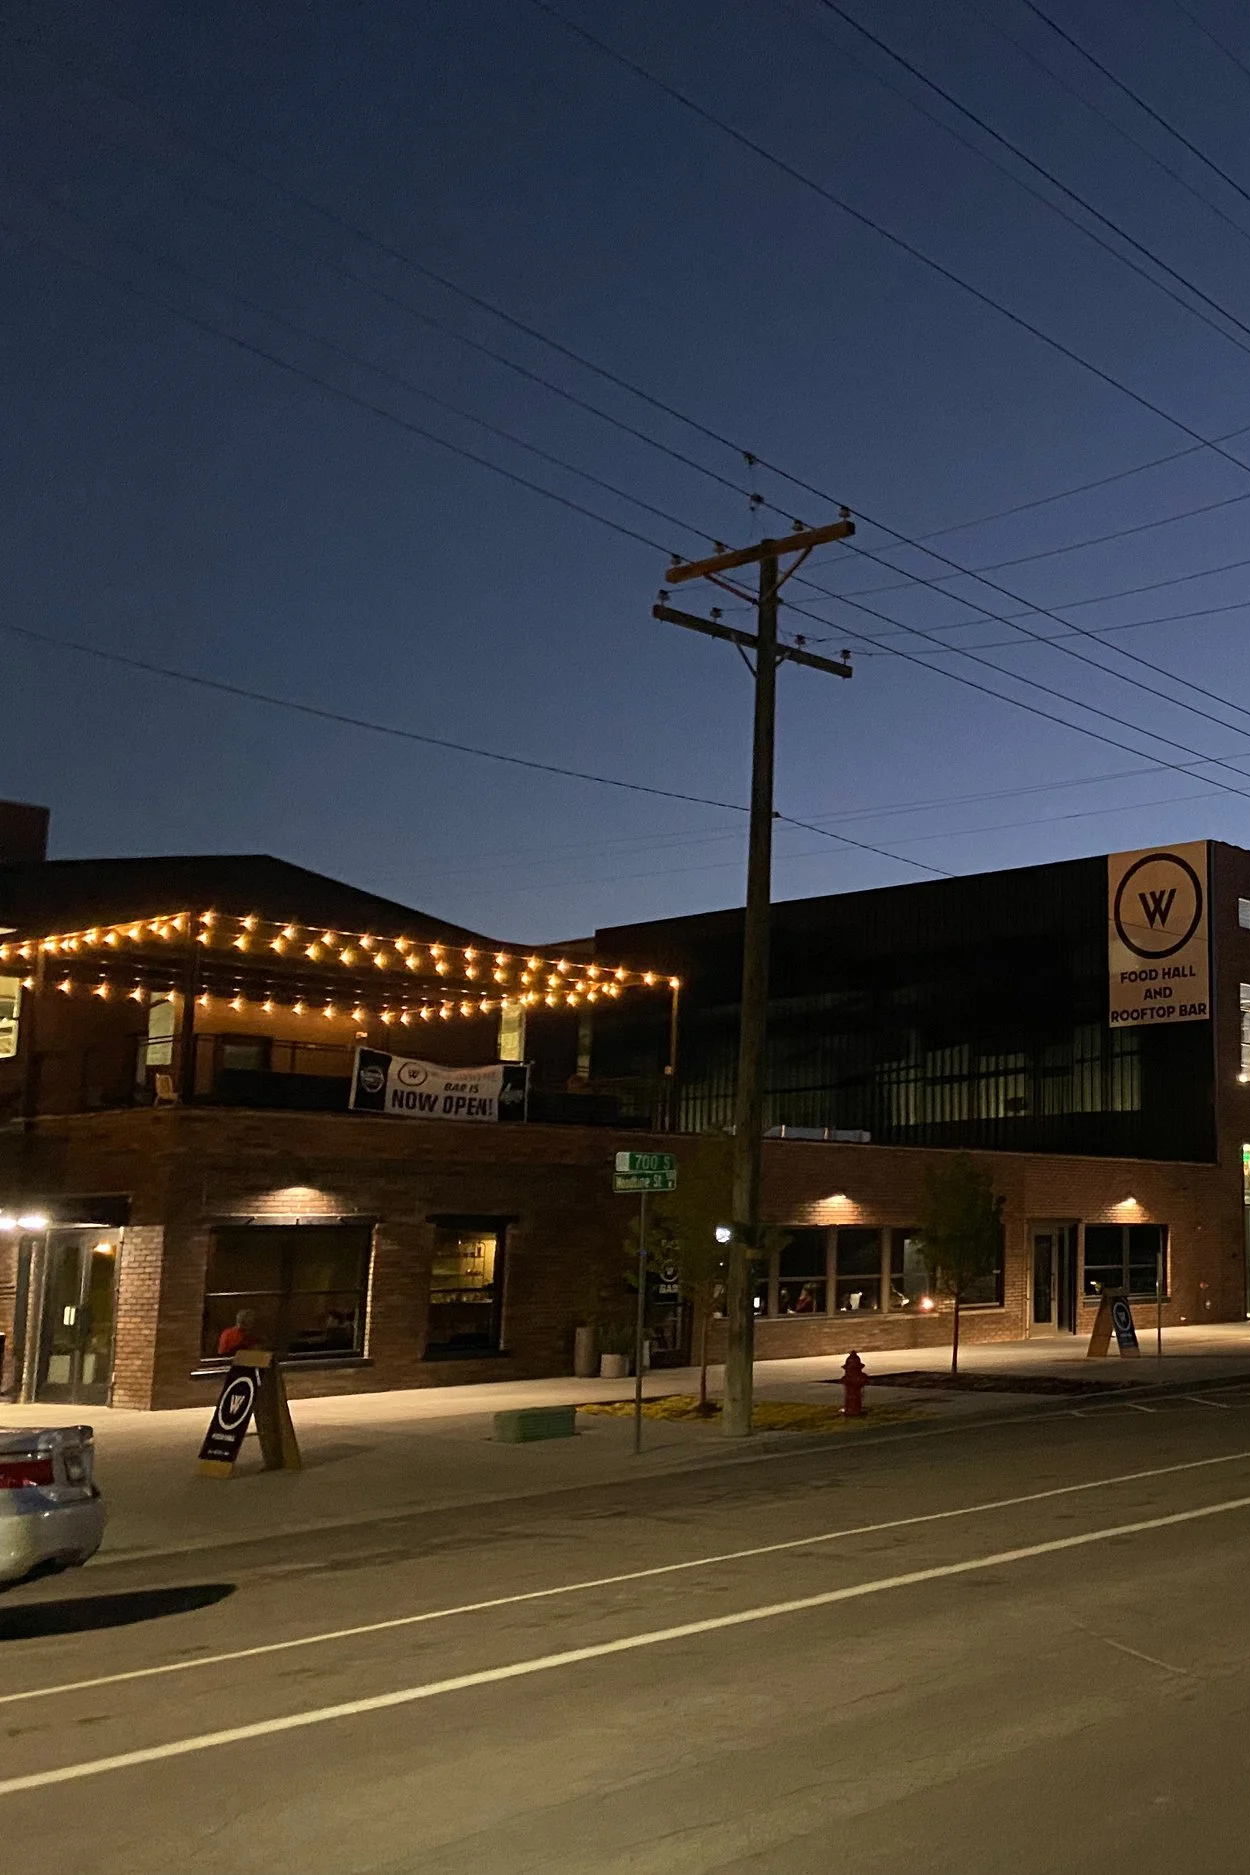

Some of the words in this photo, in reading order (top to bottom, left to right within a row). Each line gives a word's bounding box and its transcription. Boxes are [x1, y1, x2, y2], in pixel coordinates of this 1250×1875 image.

[1138, 888, 1177, 929] W
[1120, 969, 1158, 984] FOOD
[1162, 965, 1196, 980] HALL
[1143, 986, 1173, 1001] AND
[1111, 1006, 1175, 1023] ROOFTOP
[1179, 1003, 1207, 1017] BAR
[444, 1083, 466, 1092] BAR
[468, 1083, 479, 1093] IS
[391, 1089, 439, 1113] NOW
[442, 1095, 493, 1116] OPEN!
[635, 1154, 658, 1170] 700
[663, 1155, 671, 1170] S
